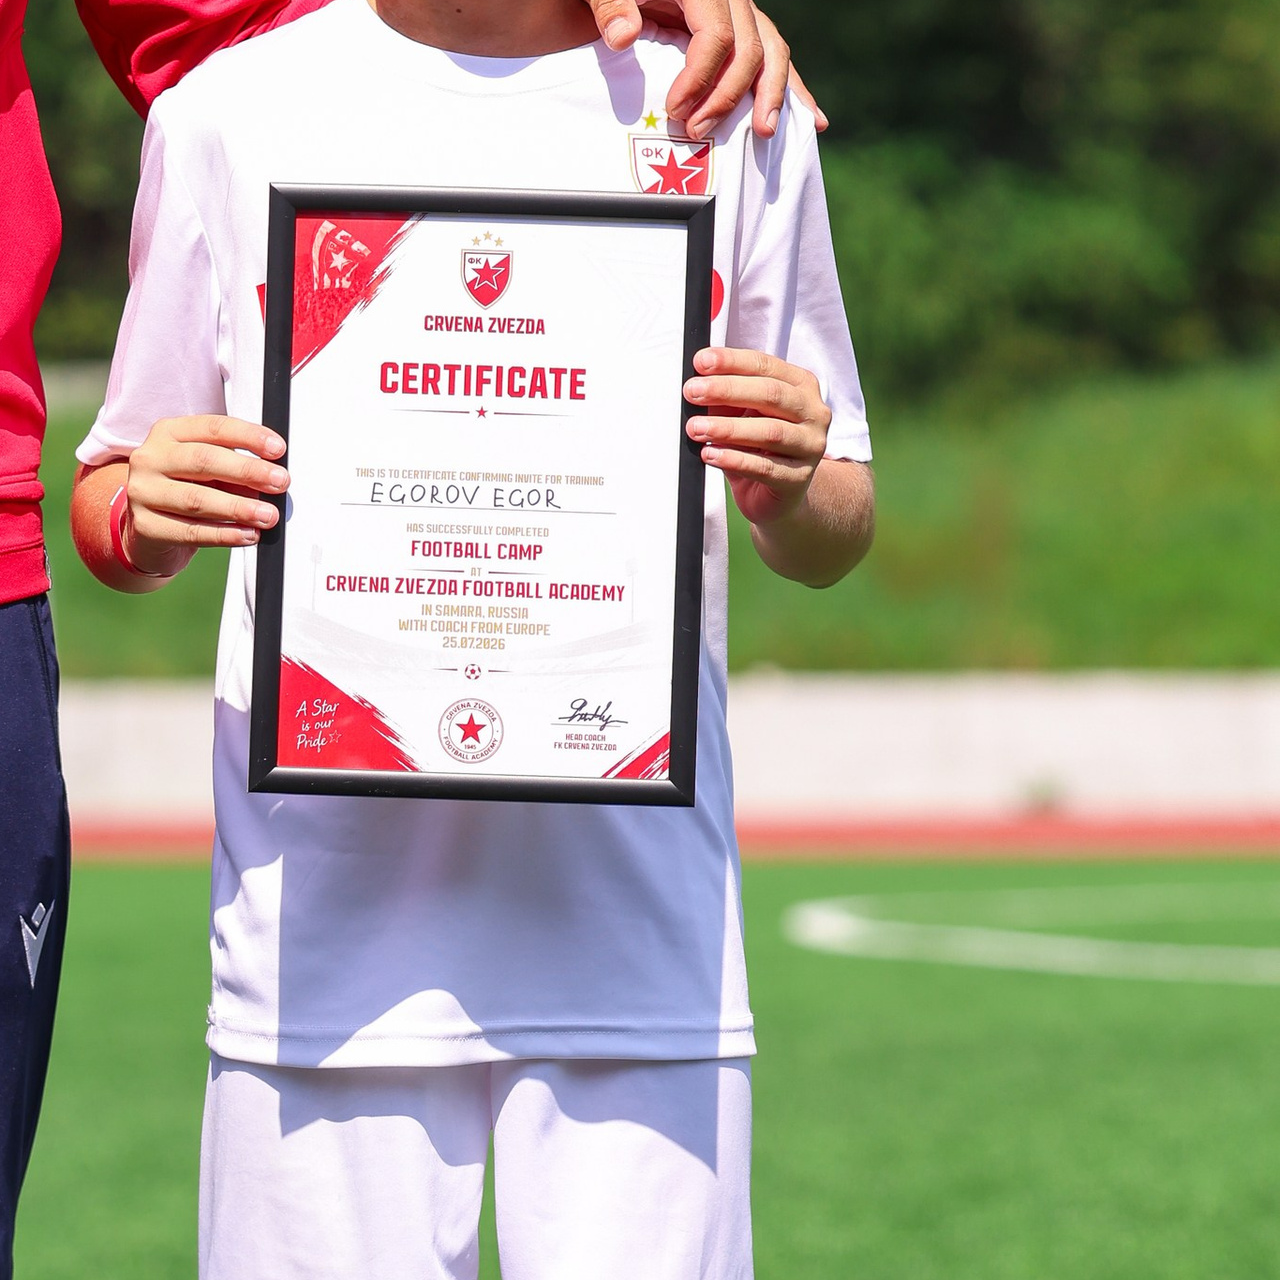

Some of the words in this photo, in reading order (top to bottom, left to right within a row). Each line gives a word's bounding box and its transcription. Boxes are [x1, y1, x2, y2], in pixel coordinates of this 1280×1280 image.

[641, 147, 664, 160] ФК
[467, 257, 482, 265] ФК
[424, 315, 484, 333] CRVENA
[488, 317, 546, 335] ZVEZDA
[380, 362, 586, 400] CERTIFICATE
[356, 468, 375, 478] THIS
[377, 469, 386, 478] IS
[388, 469, 400, 479] TO
[402, 470, 457, 481] CERTIFICATE
[459, 472, 513, 483] CONFIRMING
[515, 474, 542, 484] INVITE
[545, 475, 562, 484] FOR
[565, 476, 604, 486] TRAINING
[370, 482, 480, 505] EGOROV
[493, 488, 561, 509] EGOR
[406, 523, 424, 533] HAS
[427, 524, 493, 535] SUCCESSFULLY
[496, 527, 549, 537] COMPLETED
[411, 541, 491, 558] FOOTBALL
[497, 544, 543, 561] CAMP
[471, 568, 481, 576] AT
[326, 575, 389, 593] CRVENA
[394, 578, 457, 595] ZVEZDA
[462, 580, 543, 598] FOOTBALL
[548, 584, 625, 601] ACADEMY
[421, 604, 432, 616] IN
[435, 605, 485, 618] SAMARA,
[488, 607, 528, 619] RUSSIA
[398, 619, 427, 632] WITH
[430, 620, 468, 633] COACH
[471, 622, 503, 634] FROM
[506, 624, 550, 636] EUROPE
[442, 636, 505, 650] 25.07.2026
[295, 700, 307, 718] A
[311, 698, 340, 718] Star
[446, 702, 471, 720] CRVENA
[473, 702, 497, 722] ZVEZDA
[302, 720, 311, 732] is
[314, 719, 334, 730] our
[296, 730, 328, 753] Pride
[565, 733, 583, 741] HEAD
[584, 734, 606, 742] COACH
[443, 736, 469, 760] FOOTBALL
[471, 737, 498, 760] ACADEMY
[564, 742, 590, 750] CRVENA
[591, 743, 617, 751] ZVEZDA
